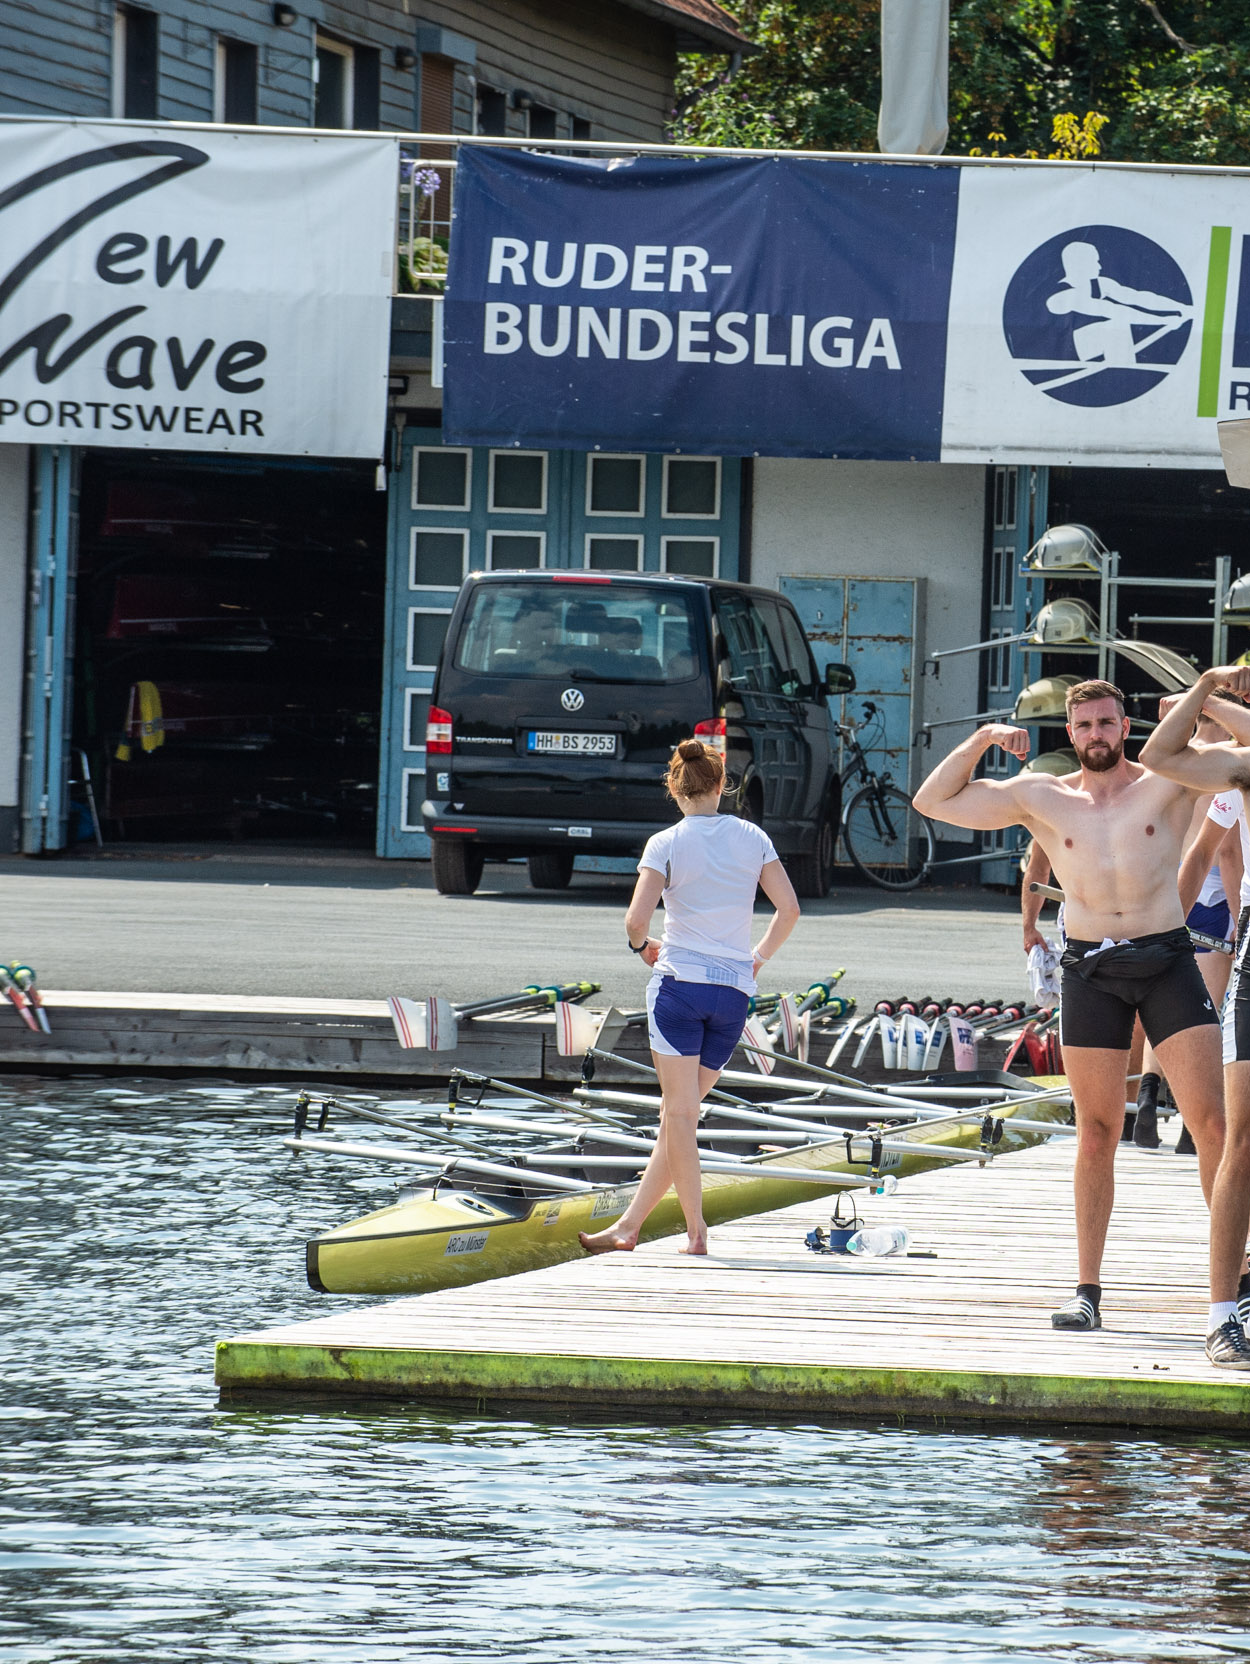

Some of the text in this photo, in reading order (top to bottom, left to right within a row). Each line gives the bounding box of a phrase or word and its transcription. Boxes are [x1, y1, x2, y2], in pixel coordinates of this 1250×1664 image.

[487, 237, 732, 293] RUDER-
[483, 302, 902, 370] BUNDESLIGA
[455, 736, 513, 745] TRANSPORTER
[536, 734, 615, 751] HH BS 2953
